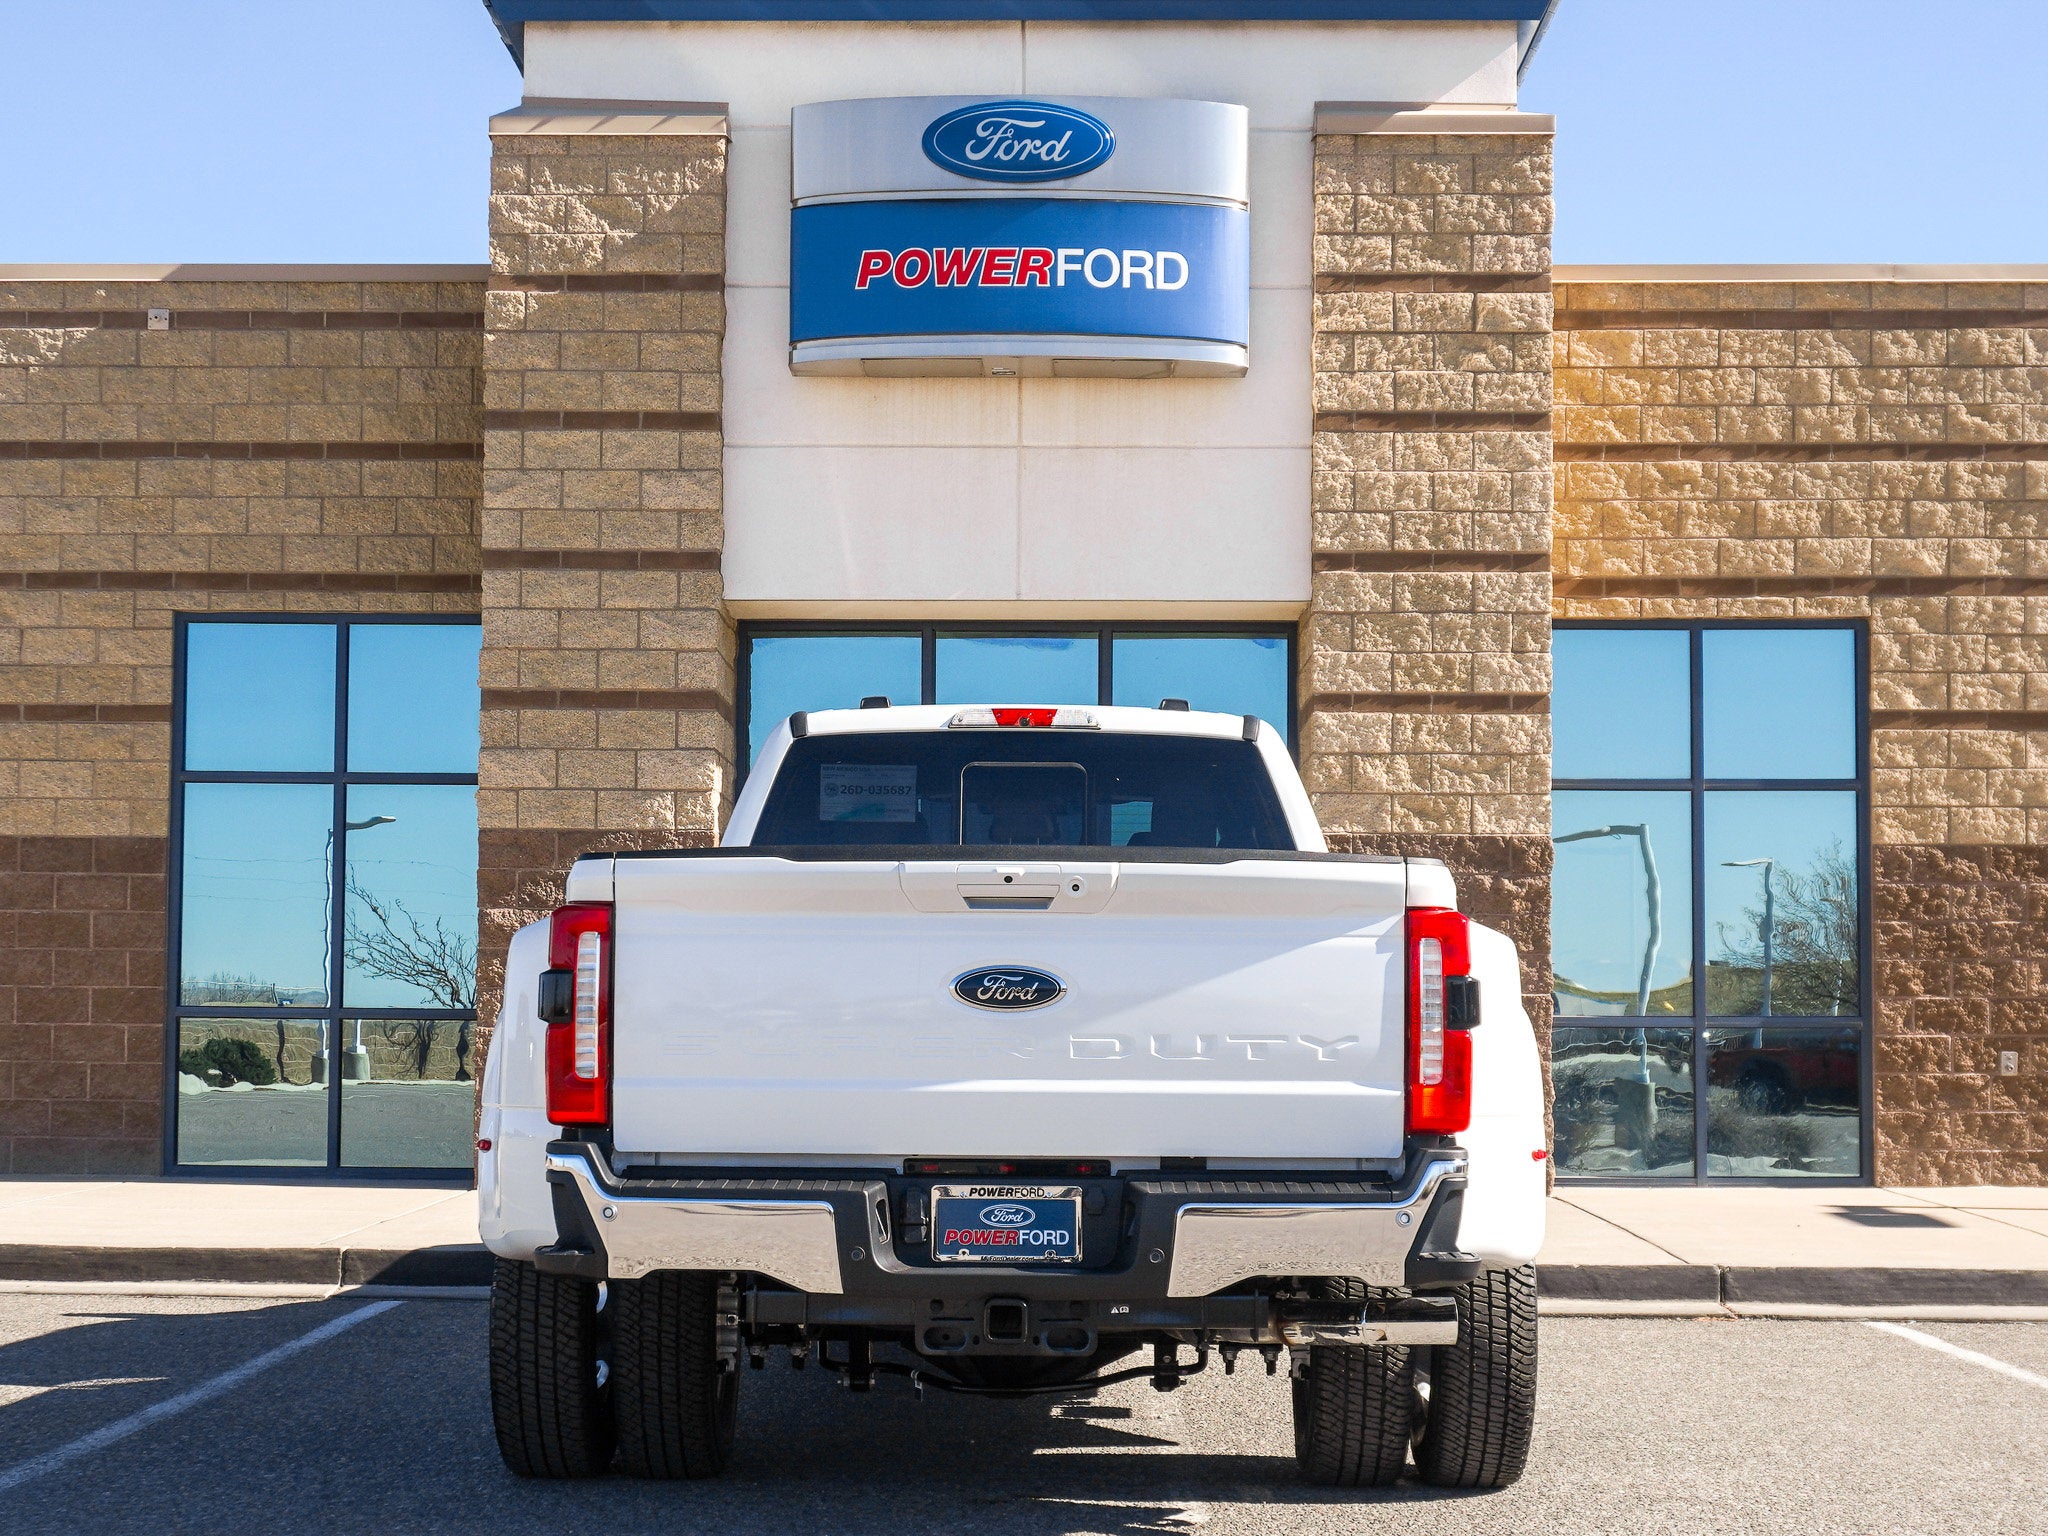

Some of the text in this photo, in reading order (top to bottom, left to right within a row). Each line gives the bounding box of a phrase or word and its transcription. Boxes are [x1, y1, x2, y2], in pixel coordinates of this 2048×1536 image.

[965, 117, 1073, 163] Ford
[854, 247, 1190, 291] POWERFORD
[840, 784, 912, 796] 26D-035687
[977, 975, 1039, 1001] Ford
[1069, 1033, 1360, 1062] DUTY
[968, 1187, 1045, 1198] POWERFORD
[990, 1208, 1024, 1222] Ford
[944, 1229, 1069, 1246] POWERFORD
